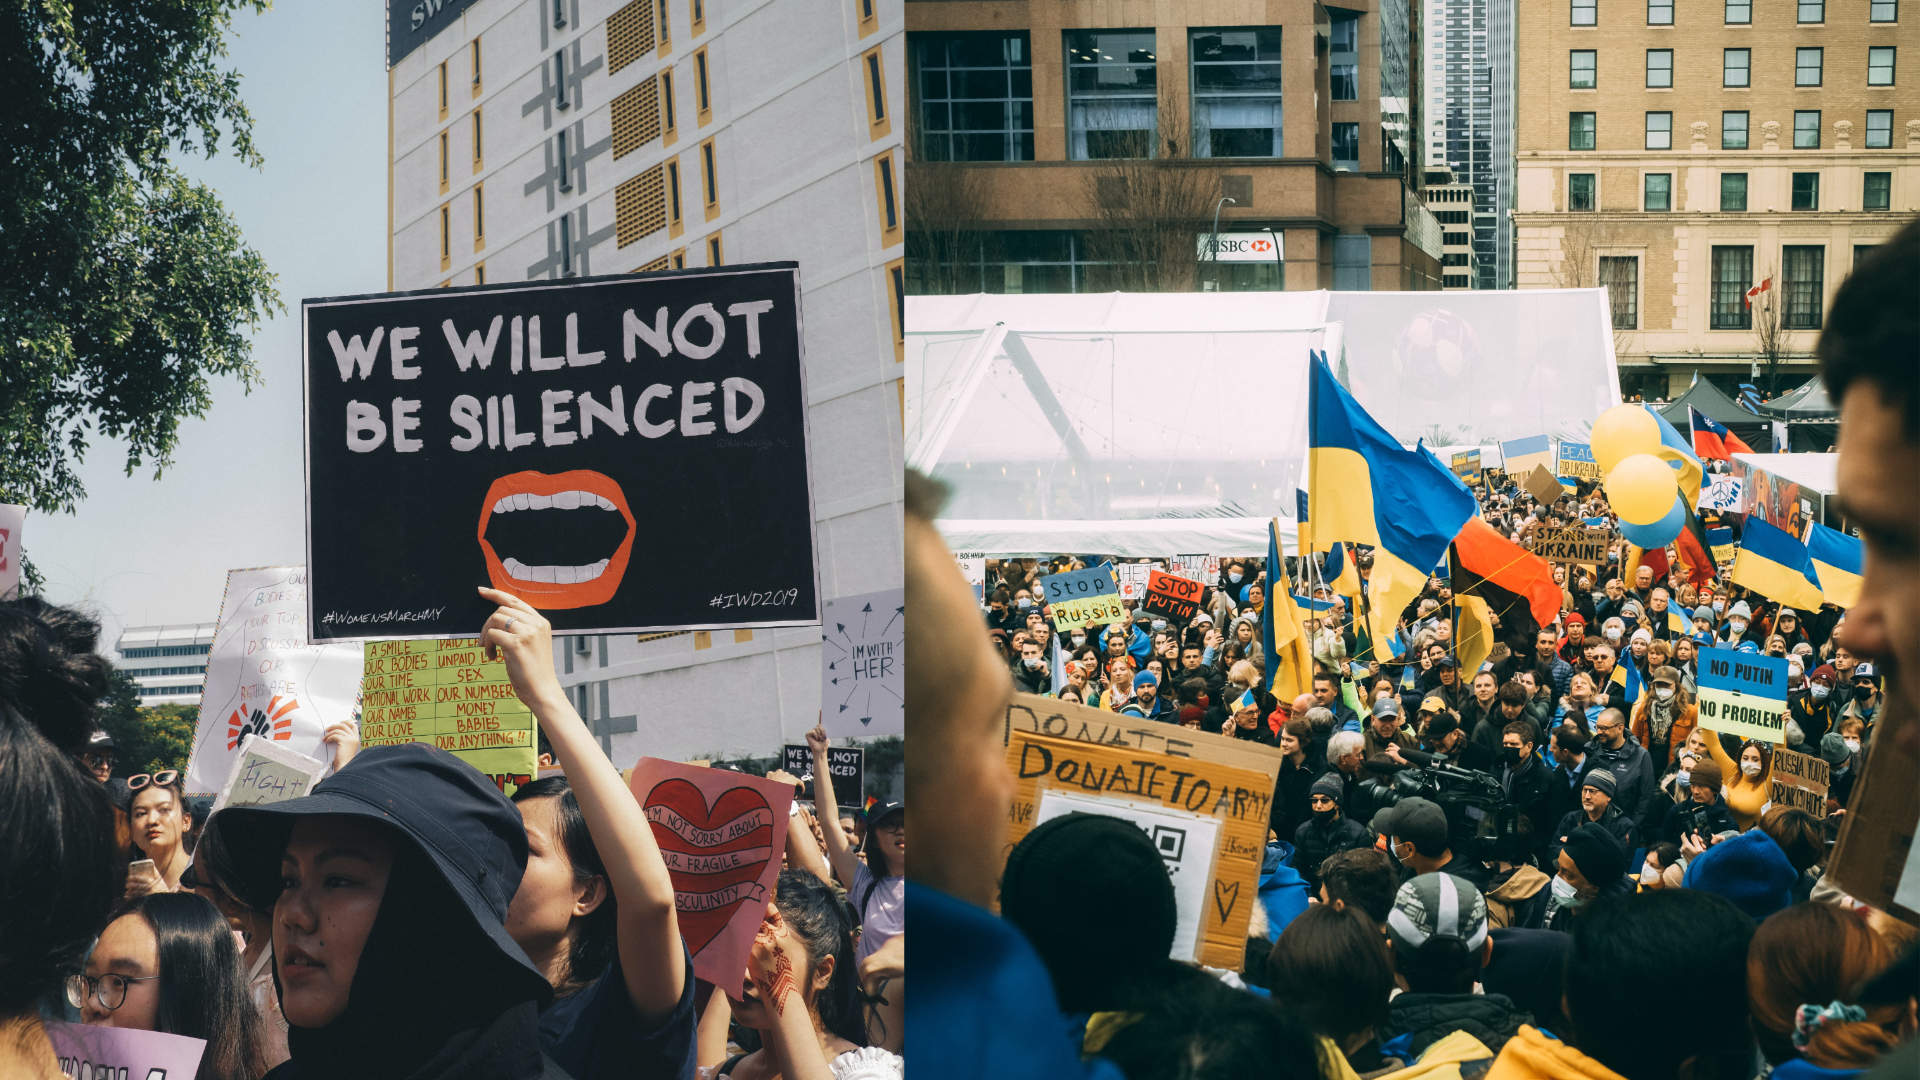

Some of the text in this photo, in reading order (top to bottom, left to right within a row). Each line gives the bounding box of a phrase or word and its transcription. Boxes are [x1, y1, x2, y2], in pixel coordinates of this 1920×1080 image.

[1209, 240, 1249, 252] HSBC
[327, 299, 774, 382] WE WILL NOT
[346, 377, 765, 453] BE SILENCED
[1561, 445, 1594, 460] PEAC
[1570, 462, 1603, 478] UKRAINE
[1536, 527, 1606, 541] STAND WITH
[1535, 542, 1604, 561] UKRAINE
[1050, 578, 1104, 597] Stop
[1154, 576, 1198, 598] STOP
[255, 590, 293, 607] BODIES
[709, 588, 798, 609] #IWD2019
[1146, 593, 1193, 618] PUTIN
[1056, 604, 1121, 624] Russia
[370, 640, 411, 657] A SMILE
[866, 641, 893, 657] WITH
[260, 660, 283, 674] OUR
[365, 653, 428, 675] OUR BODIES
[438, 652, 476, 668] UNPAID
[854, 656, 894, 680] HER
[366, 672, 413, 690] OUR TIME
[457, 668, 484, 683] SEX
[1710, 659, 1773, 686] NO PUTIN
[402, 688, 431, 704] WORK
[437, 683, 517, 702] OUR NUMBER
[366, 705, 417, 723] OUR NAMES
[456, 701, 496, 716] MONEY
[1700, 699, 1783, 730] NO PROBLEM
[364, 722, 413, 739] OUR LOVE
[457, 716, 500, 733] BABIES
[1004, 704, 1193, 757] DONATE
[436, 735, 456, 749] OUR
[459, 731, 514, 749] ANYTHING
[787, 748, 802, 760] WE
[834, 752, 859, 764] NOT
[242, 759, 303, 799] FIGHT
[1018, 742, 1166, 799] DONATE
[1213, 785, 1271, 822] ARMY
[1772, 782, 1796, 807] DRUNK
[1806, 791, 1824, 818] HOME
[667, 813, 690, 835] NOT
[689, 828, 724, 845] SORRY
[729, 813, 762, 837] ABOUT
[687, 853, 741, 872] FRAGILE
